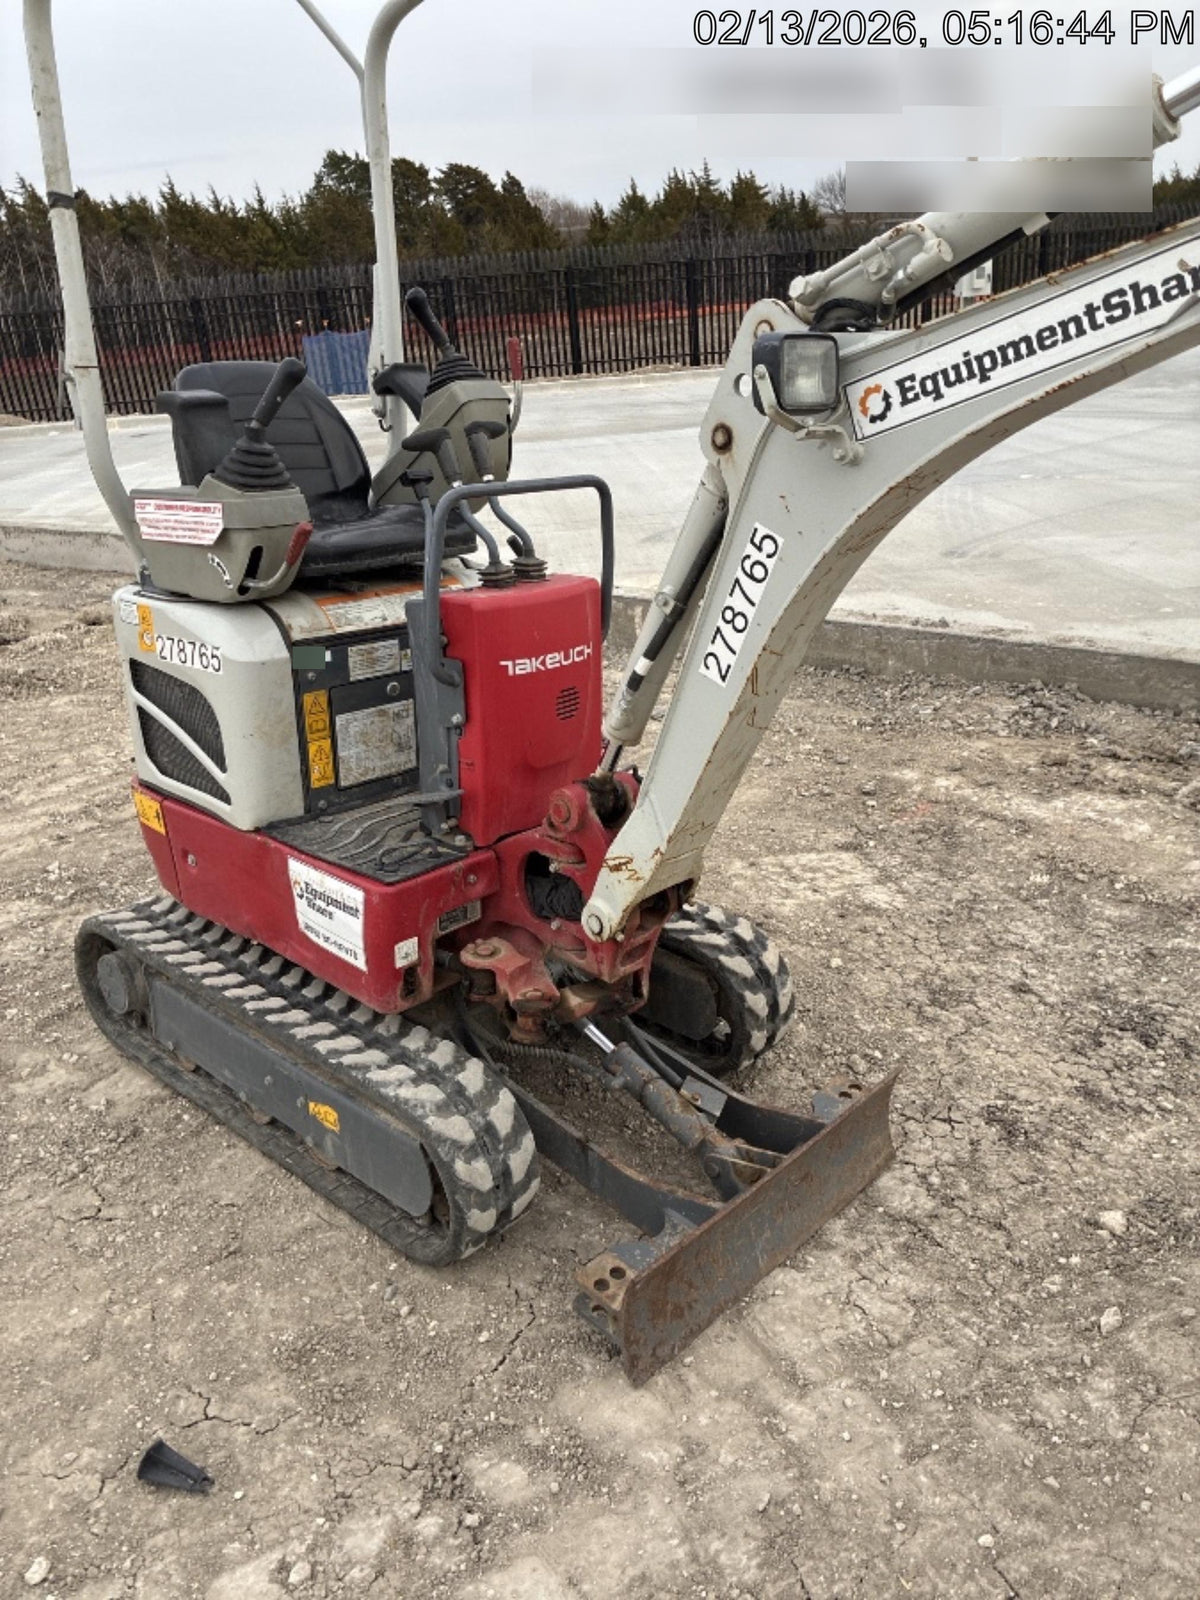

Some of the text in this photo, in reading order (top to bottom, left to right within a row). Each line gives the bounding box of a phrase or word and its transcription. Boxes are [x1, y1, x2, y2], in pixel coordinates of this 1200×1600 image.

[703, 527, 779, 682] 278765
[156, 634, 221, 673] 278765
[304, 881, 360, 920] Equipment
